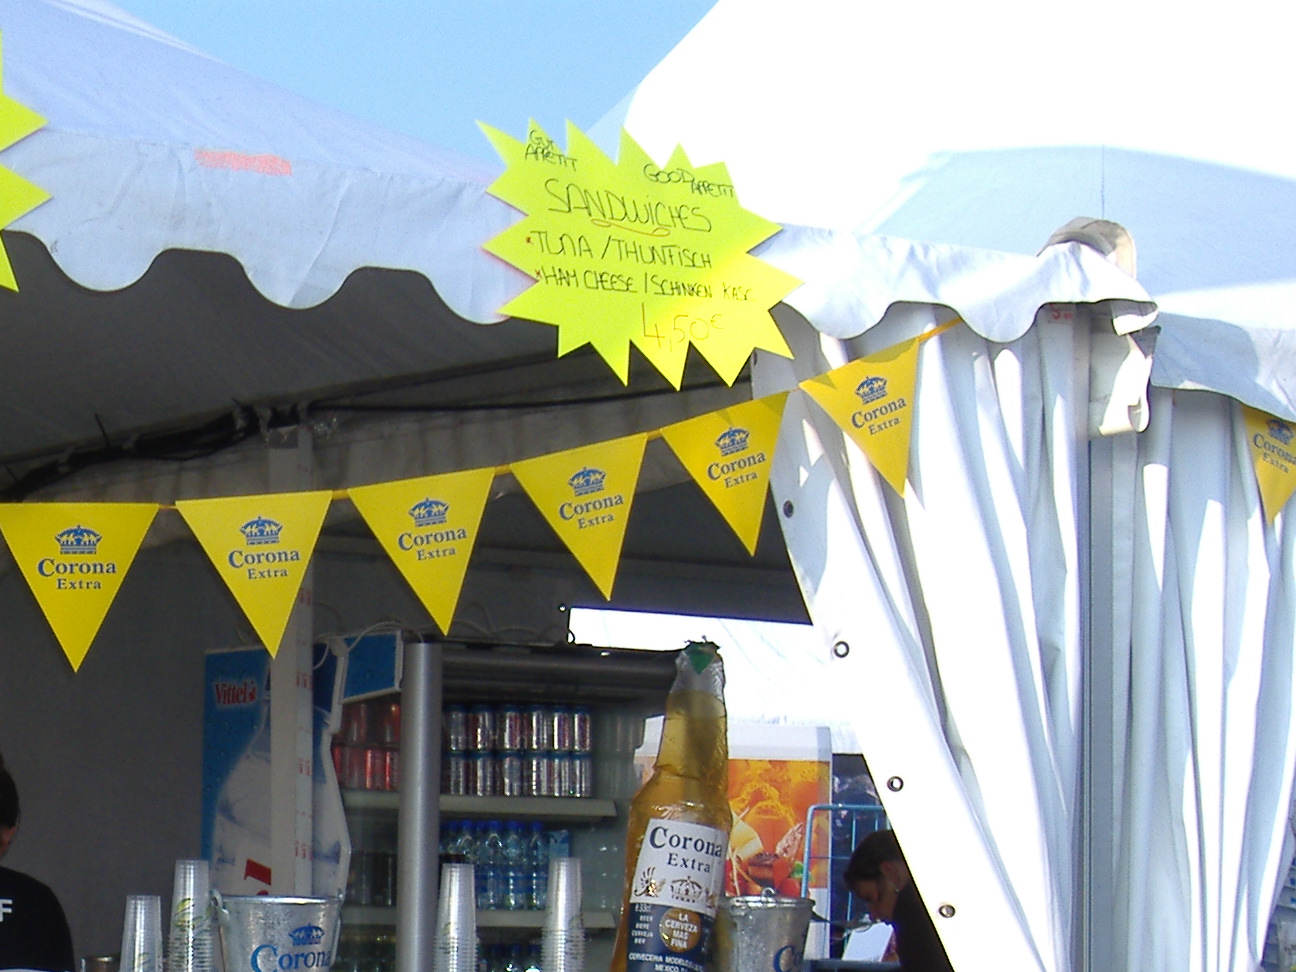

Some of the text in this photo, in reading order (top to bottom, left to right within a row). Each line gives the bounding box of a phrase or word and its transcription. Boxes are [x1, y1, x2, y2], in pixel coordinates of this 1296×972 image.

[643, 163, 695, 184] GOOD
[544, 177, 712, 233] SANDWICHES
[584, 269, 638, 294] CHEESE
[851, 396, 907, 429] Corona
[868, 416, 901, 436] Extra
[707, 450, 766, 480] Corona
[724, 471, 758, 489] Extra
[559, 492, 624, 521] Corona
[577, 512, 615, 530] Extra
[397, 526, 468, 552] Corona
[228, 548, 301, 569] Corona
[416, 545, 457, 562] Extra
[37, 557, 117, 579] Corona
[247, 566, 289, 580] Extra
[56, 578, 102, 591] Extra
[215, 682, 247, 704] Vittel
[649, 826, 723, 859] Corona
[667, 852, 711, 873] Extra
